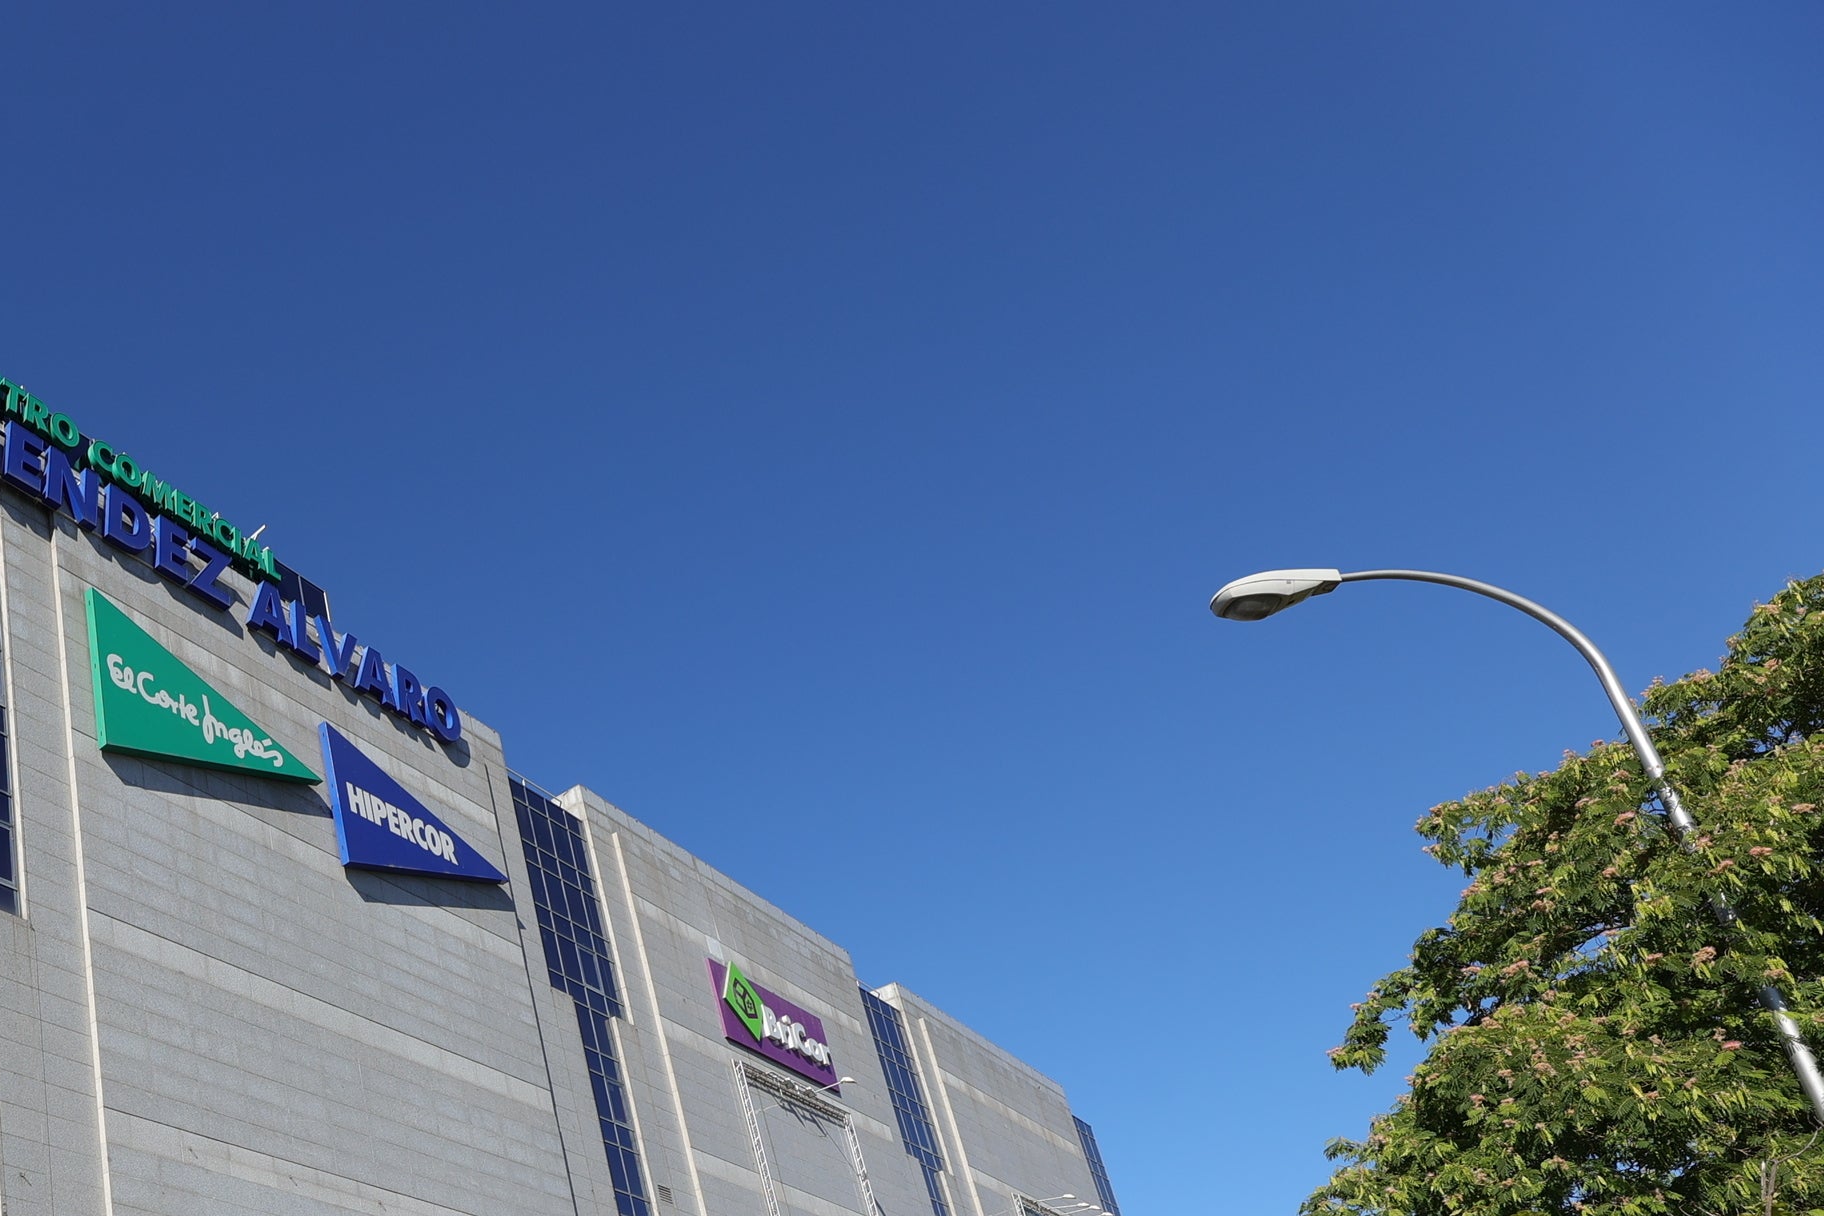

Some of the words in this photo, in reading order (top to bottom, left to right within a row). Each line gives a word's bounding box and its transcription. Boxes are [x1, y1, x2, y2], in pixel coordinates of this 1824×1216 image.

[88, 440, 282, 583] COMERCIAL
[106, 653, 137, 694] El
[136, 673, 200, 726] Corte
[201, 694, 284, 767] Inglés
[245, 579, 462, 745] ALVARO
[345, 781, 459, 865] HIPERCOR
[760, 1004, 832, 1066] BriCor
